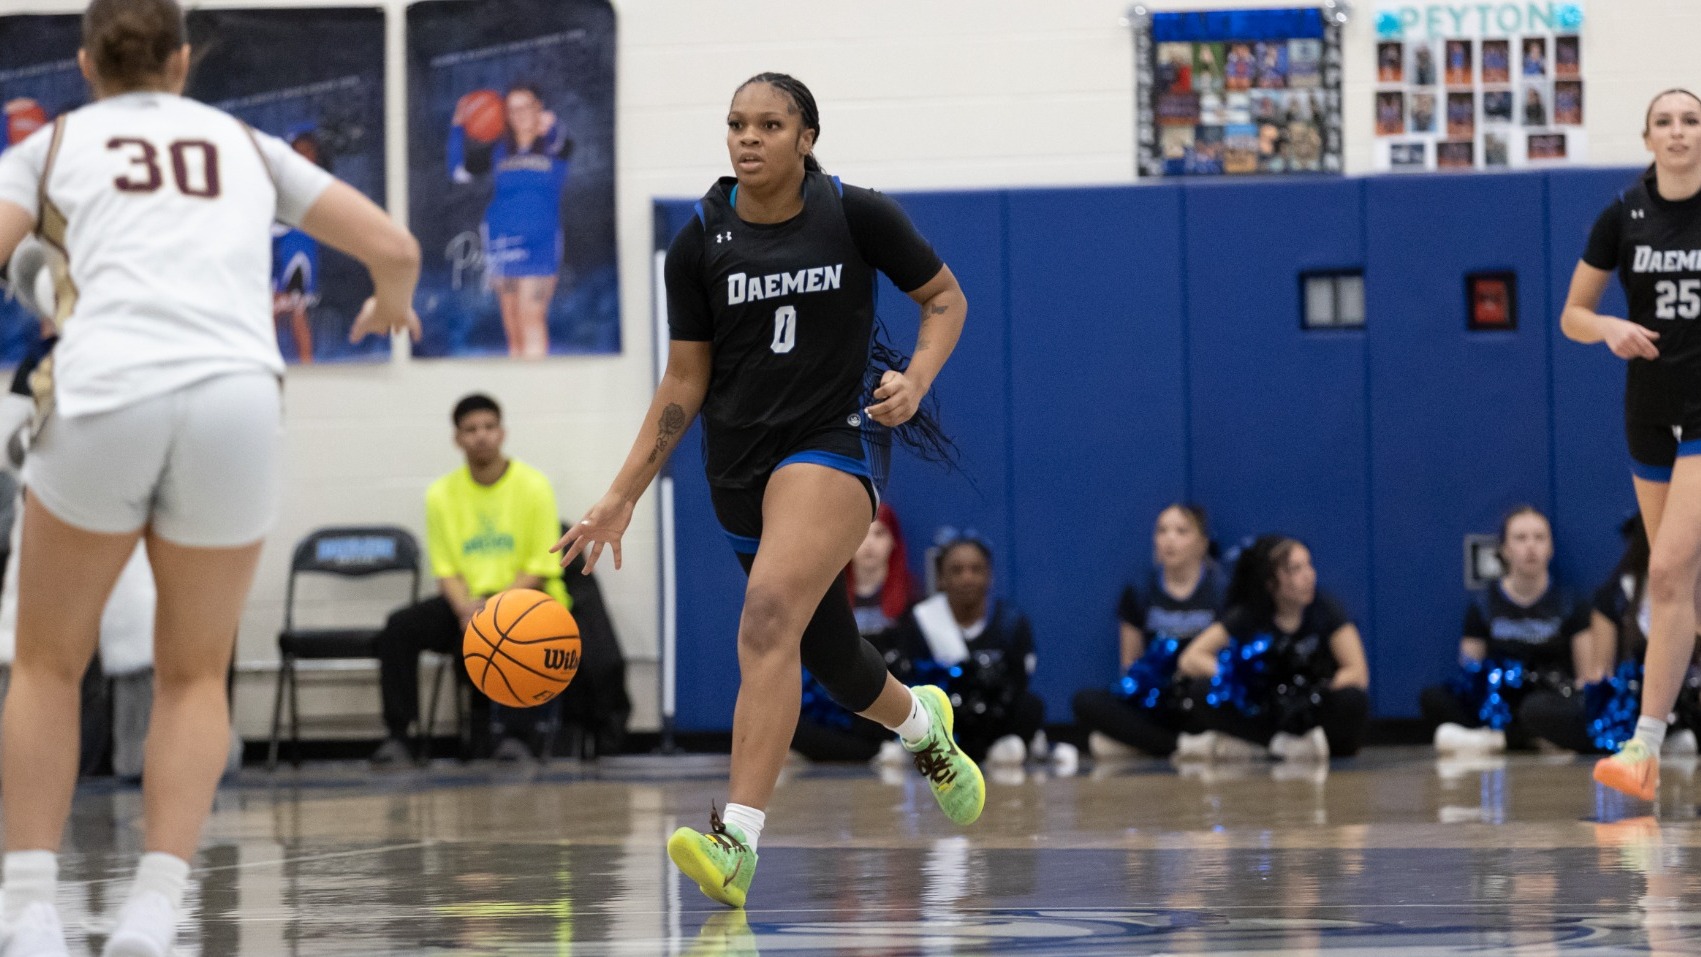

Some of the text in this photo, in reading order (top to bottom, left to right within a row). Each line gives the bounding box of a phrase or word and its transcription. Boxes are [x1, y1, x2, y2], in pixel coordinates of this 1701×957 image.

[1399, 1, 1555, 37] PEYTON
[105, 137, 220, 198] 30
[727, 263, 843, 306] DAEMEN
[1655, 278, 1701, 320] 25
[770, 305, 797, 354] 0
[544, 648, 579, 671] Wil
